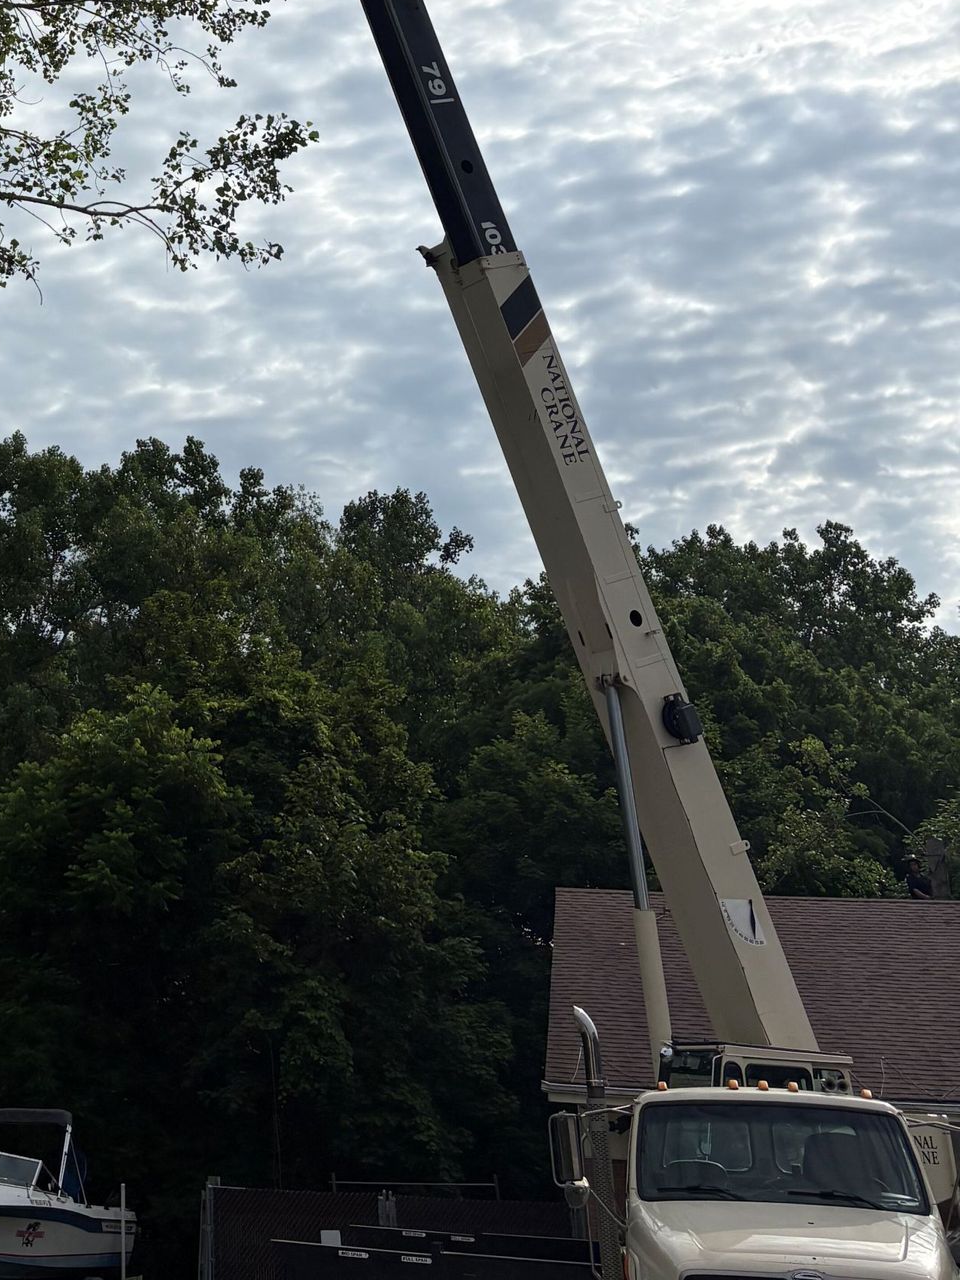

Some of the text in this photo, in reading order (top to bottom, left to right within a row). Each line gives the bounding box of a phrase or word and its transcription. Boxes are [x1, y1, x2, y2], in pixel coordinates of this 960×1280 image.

[421, 61, 448, 97] 79
[540, 387, 577, 466] CRANE
[542, 354, 590, 463] NATIONAL
